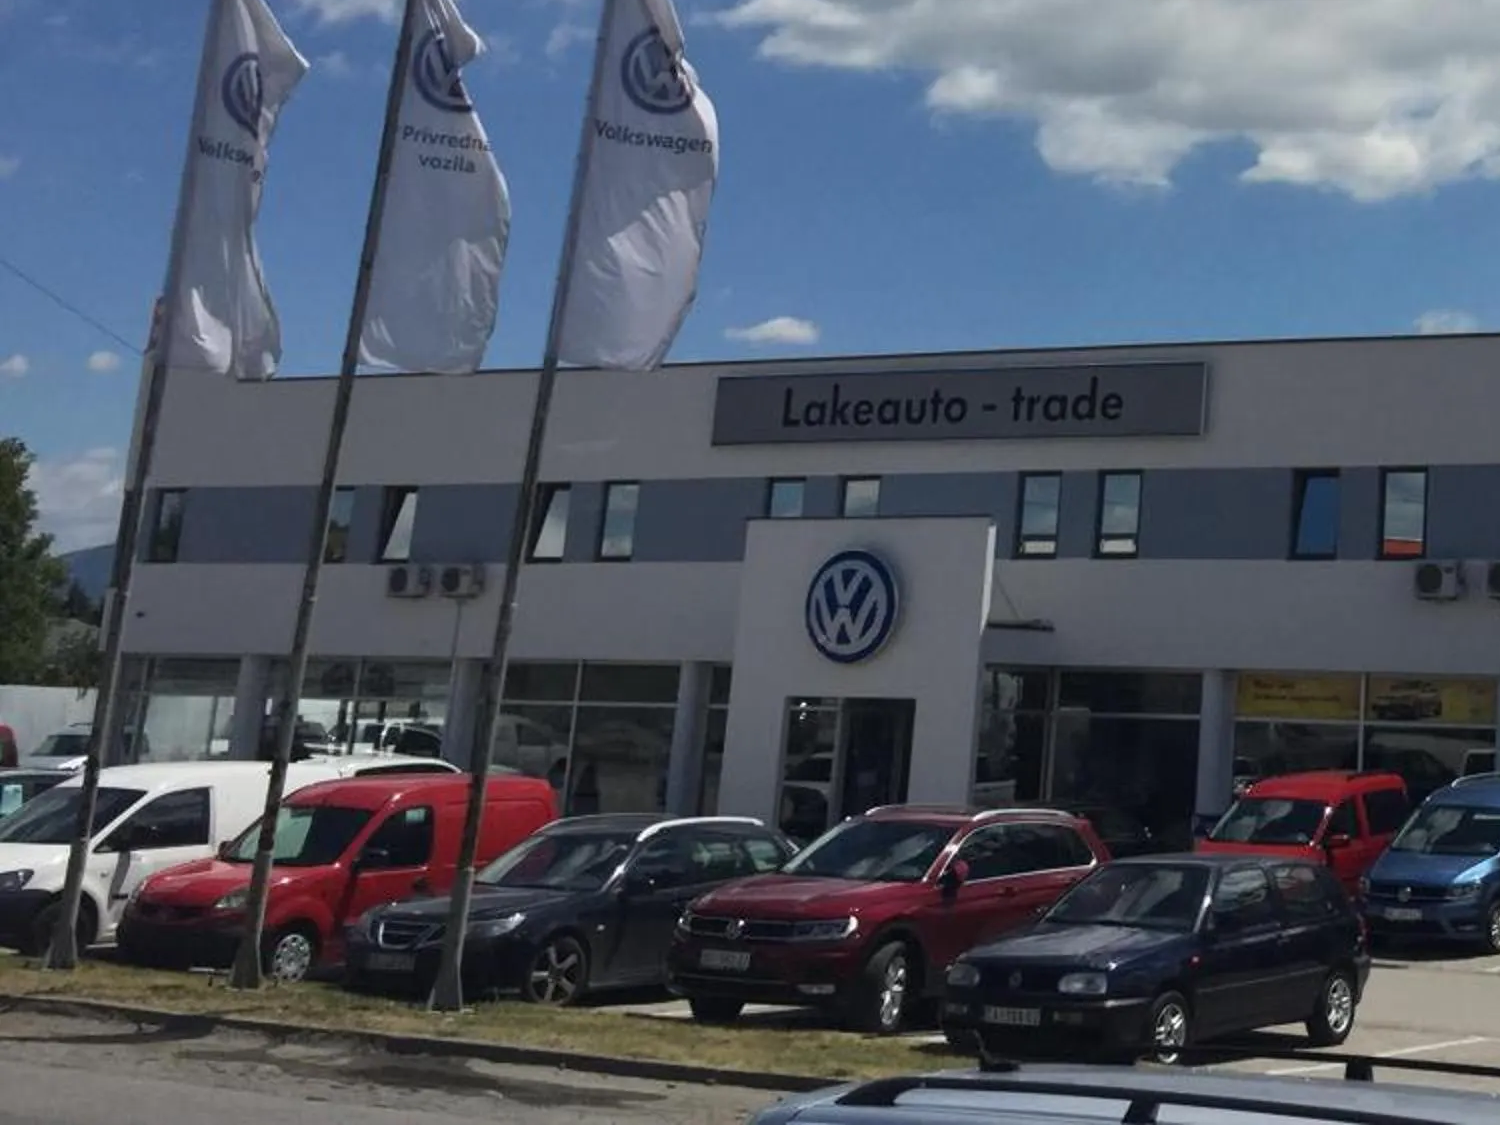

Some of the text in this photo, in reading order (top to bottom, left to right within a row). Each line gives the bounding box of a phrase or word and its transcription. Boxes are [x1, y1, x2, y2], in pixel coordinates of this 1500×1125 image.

[596, 120, 713, 154] Volkswagen
[419, 155, 476, 173] vozila
[783, 383, 967, 427] Lakeauto
[1011, 376, 1123, 422] trade
